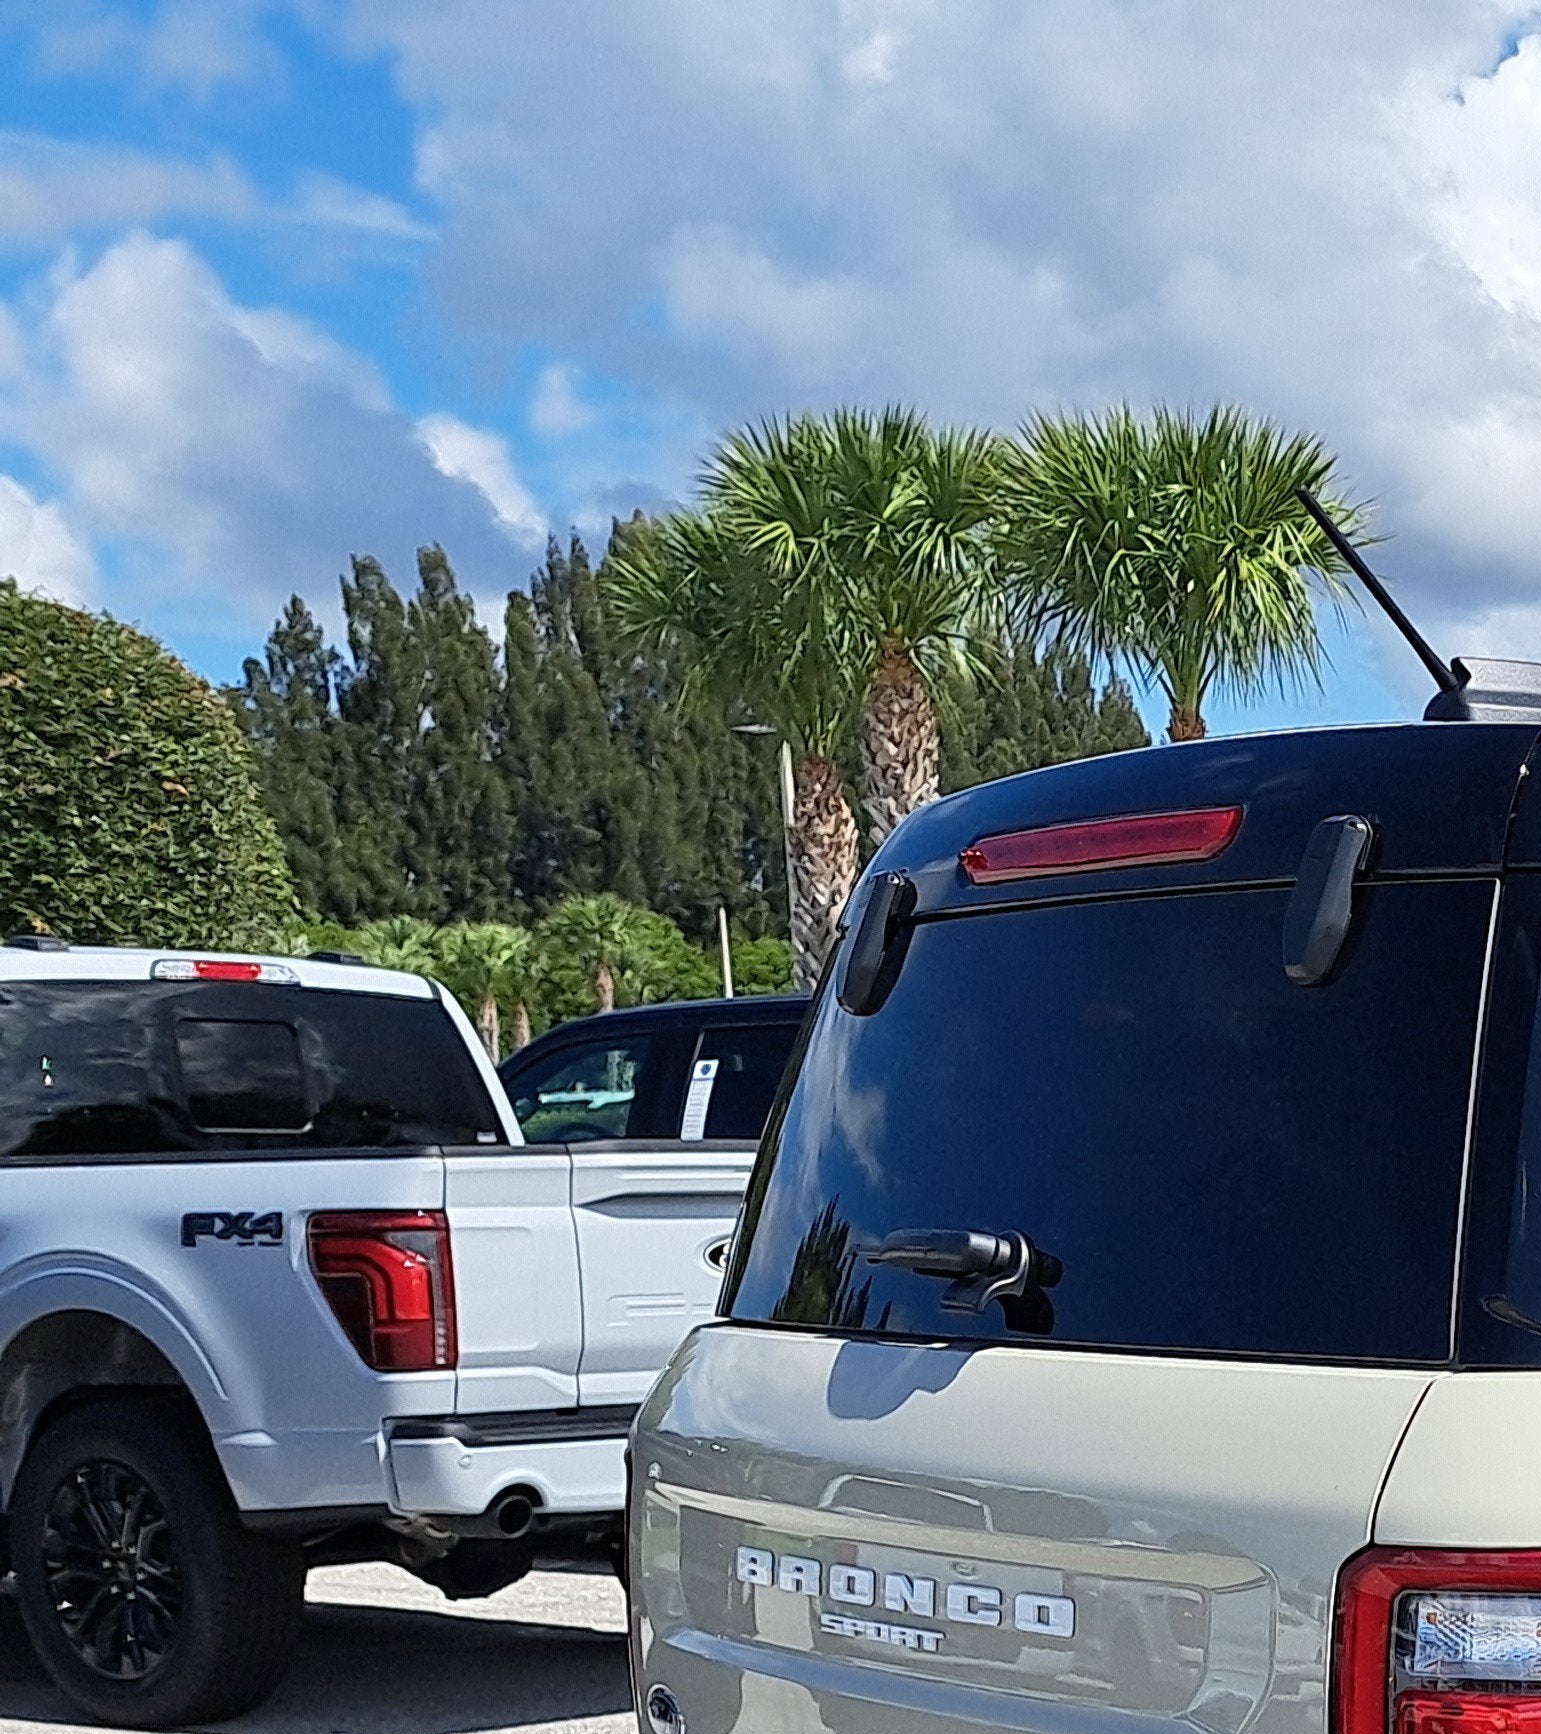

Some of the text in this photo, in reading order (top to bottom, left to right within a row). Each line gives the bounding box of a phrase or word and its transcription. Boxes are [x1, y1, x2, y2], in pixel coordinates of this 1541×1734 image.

[181, 1210, 283, 1247] FX4
[736, 1545, 1076, 1638] BRONCO
[820, 1612, 945, 1651] SPORT
